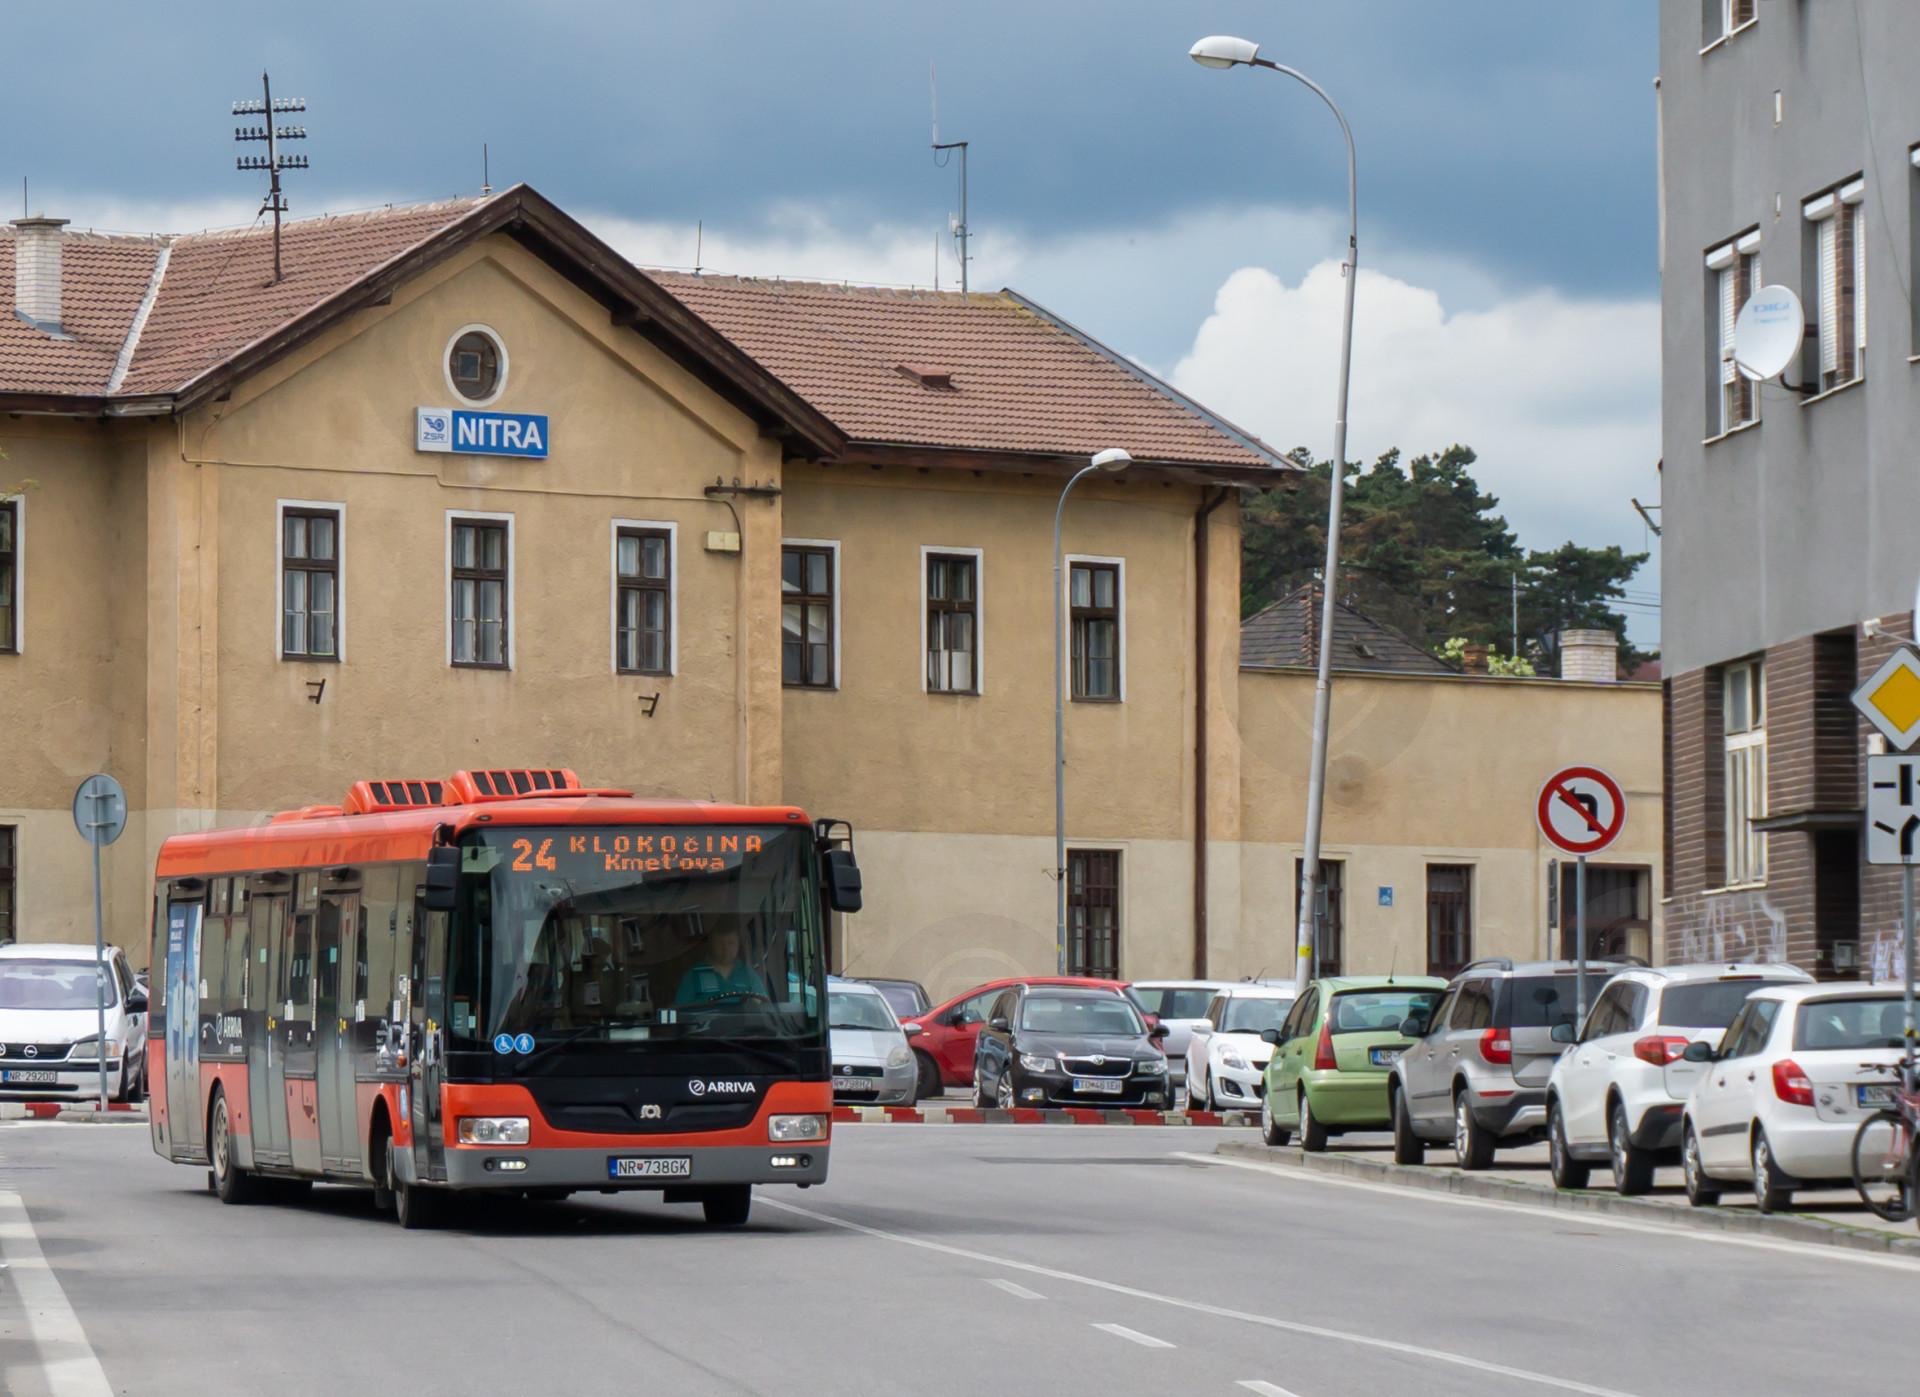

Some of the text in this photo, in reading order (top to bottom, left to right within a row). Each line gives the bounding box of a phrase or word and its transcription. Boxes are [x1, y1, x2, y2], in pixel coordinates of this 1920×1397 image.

[458, 417, 543, 449] NITRA
[512, 838, 556, 871] 24
[707, 1081, 756, 1093] ARRIVA
